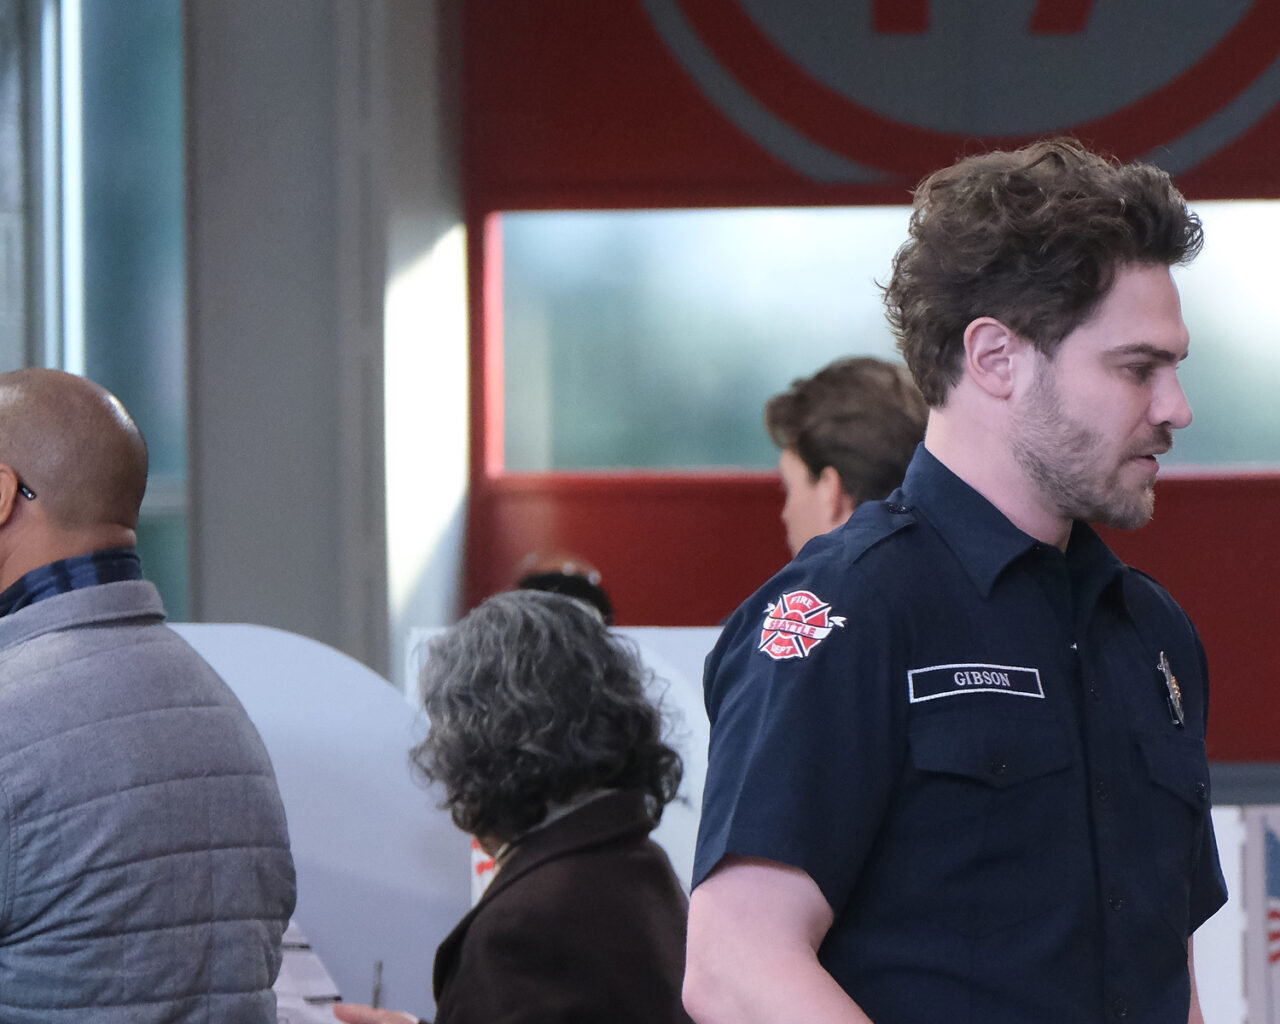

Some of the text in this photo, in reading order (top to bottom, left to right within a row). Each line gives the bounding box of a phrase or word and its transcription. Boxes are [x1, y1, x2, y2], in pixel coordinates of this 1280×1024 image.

[790, 595, 814, 609] FIRE
[768, 620, 817, 637] SEATTLE
[771, 642, 794, 655] DEPT
[953, 670, 1011, 687] GIBSON
